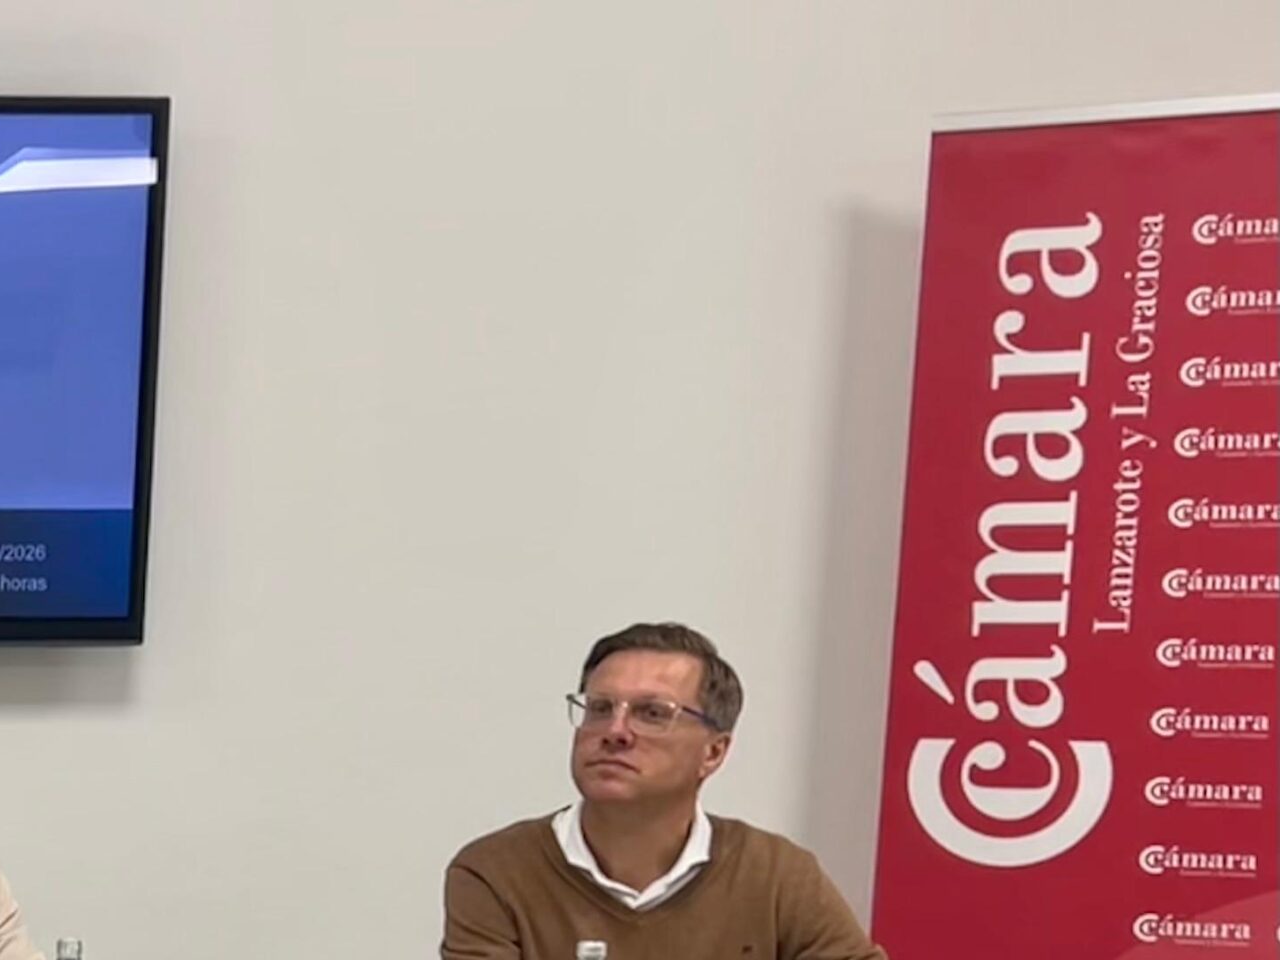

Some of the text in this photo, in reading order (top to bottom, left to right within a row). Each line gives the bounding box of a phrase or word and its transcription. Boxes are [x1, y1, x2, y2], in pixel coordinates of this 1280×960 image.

[1092, 212, 1165, 633] Lanzarote y La Graciosa
[0, 574, 48, 591] horas
